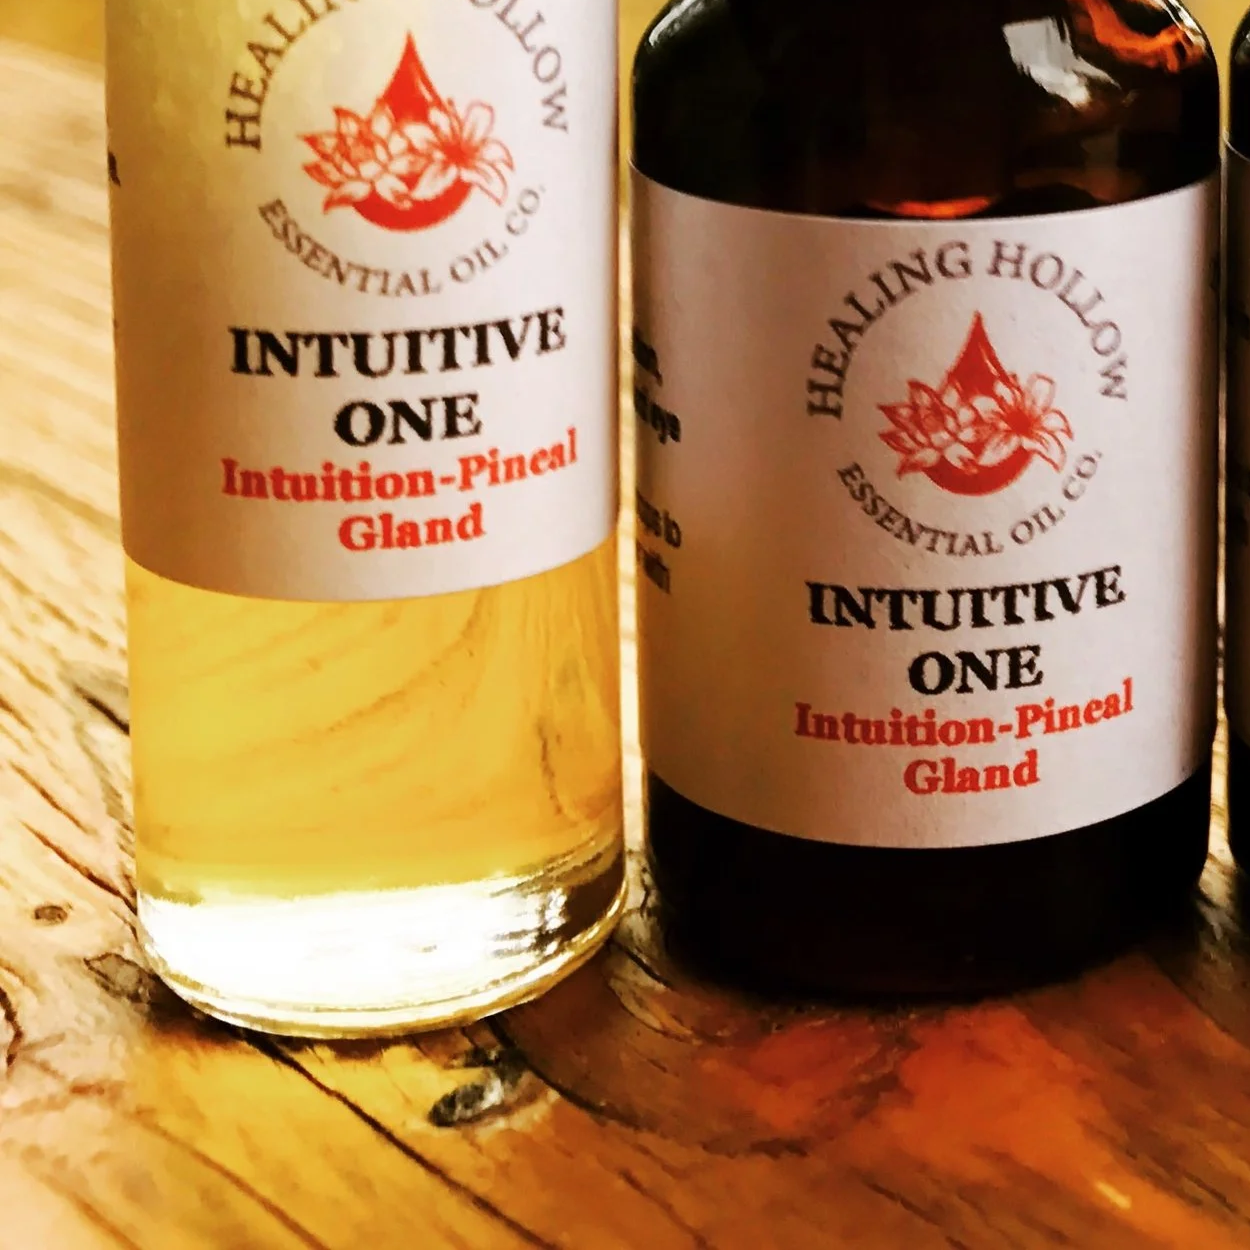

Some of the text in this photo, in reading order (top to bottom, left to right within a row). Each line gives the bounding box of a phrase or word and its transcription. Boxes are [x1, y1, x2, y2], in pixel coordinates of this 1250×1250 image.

[258, 198, 441, 297] ESSENTIAL
[450, 235, 509, 283] OIL
[228, 306, 567, 377] INTUITIVE
[807, 241, 1128, 420] HEALING HOLLOW
[334, 393, 483, 447] ONE
[219, 428, 577, 502] Intuition-Pineal
[338, 505, 485, 551] Gland
[837, 463, 1003, 557] ESSENTIAL
[1009, 504, 1064, 546] OIL
[805, 565, 1126, 630] INTUITIVE
[908, 645, 1044, 695] ONE
[794, 678, 1133, 747] Intuition-Pineal
[903, 750, 1039, 795] Gland
